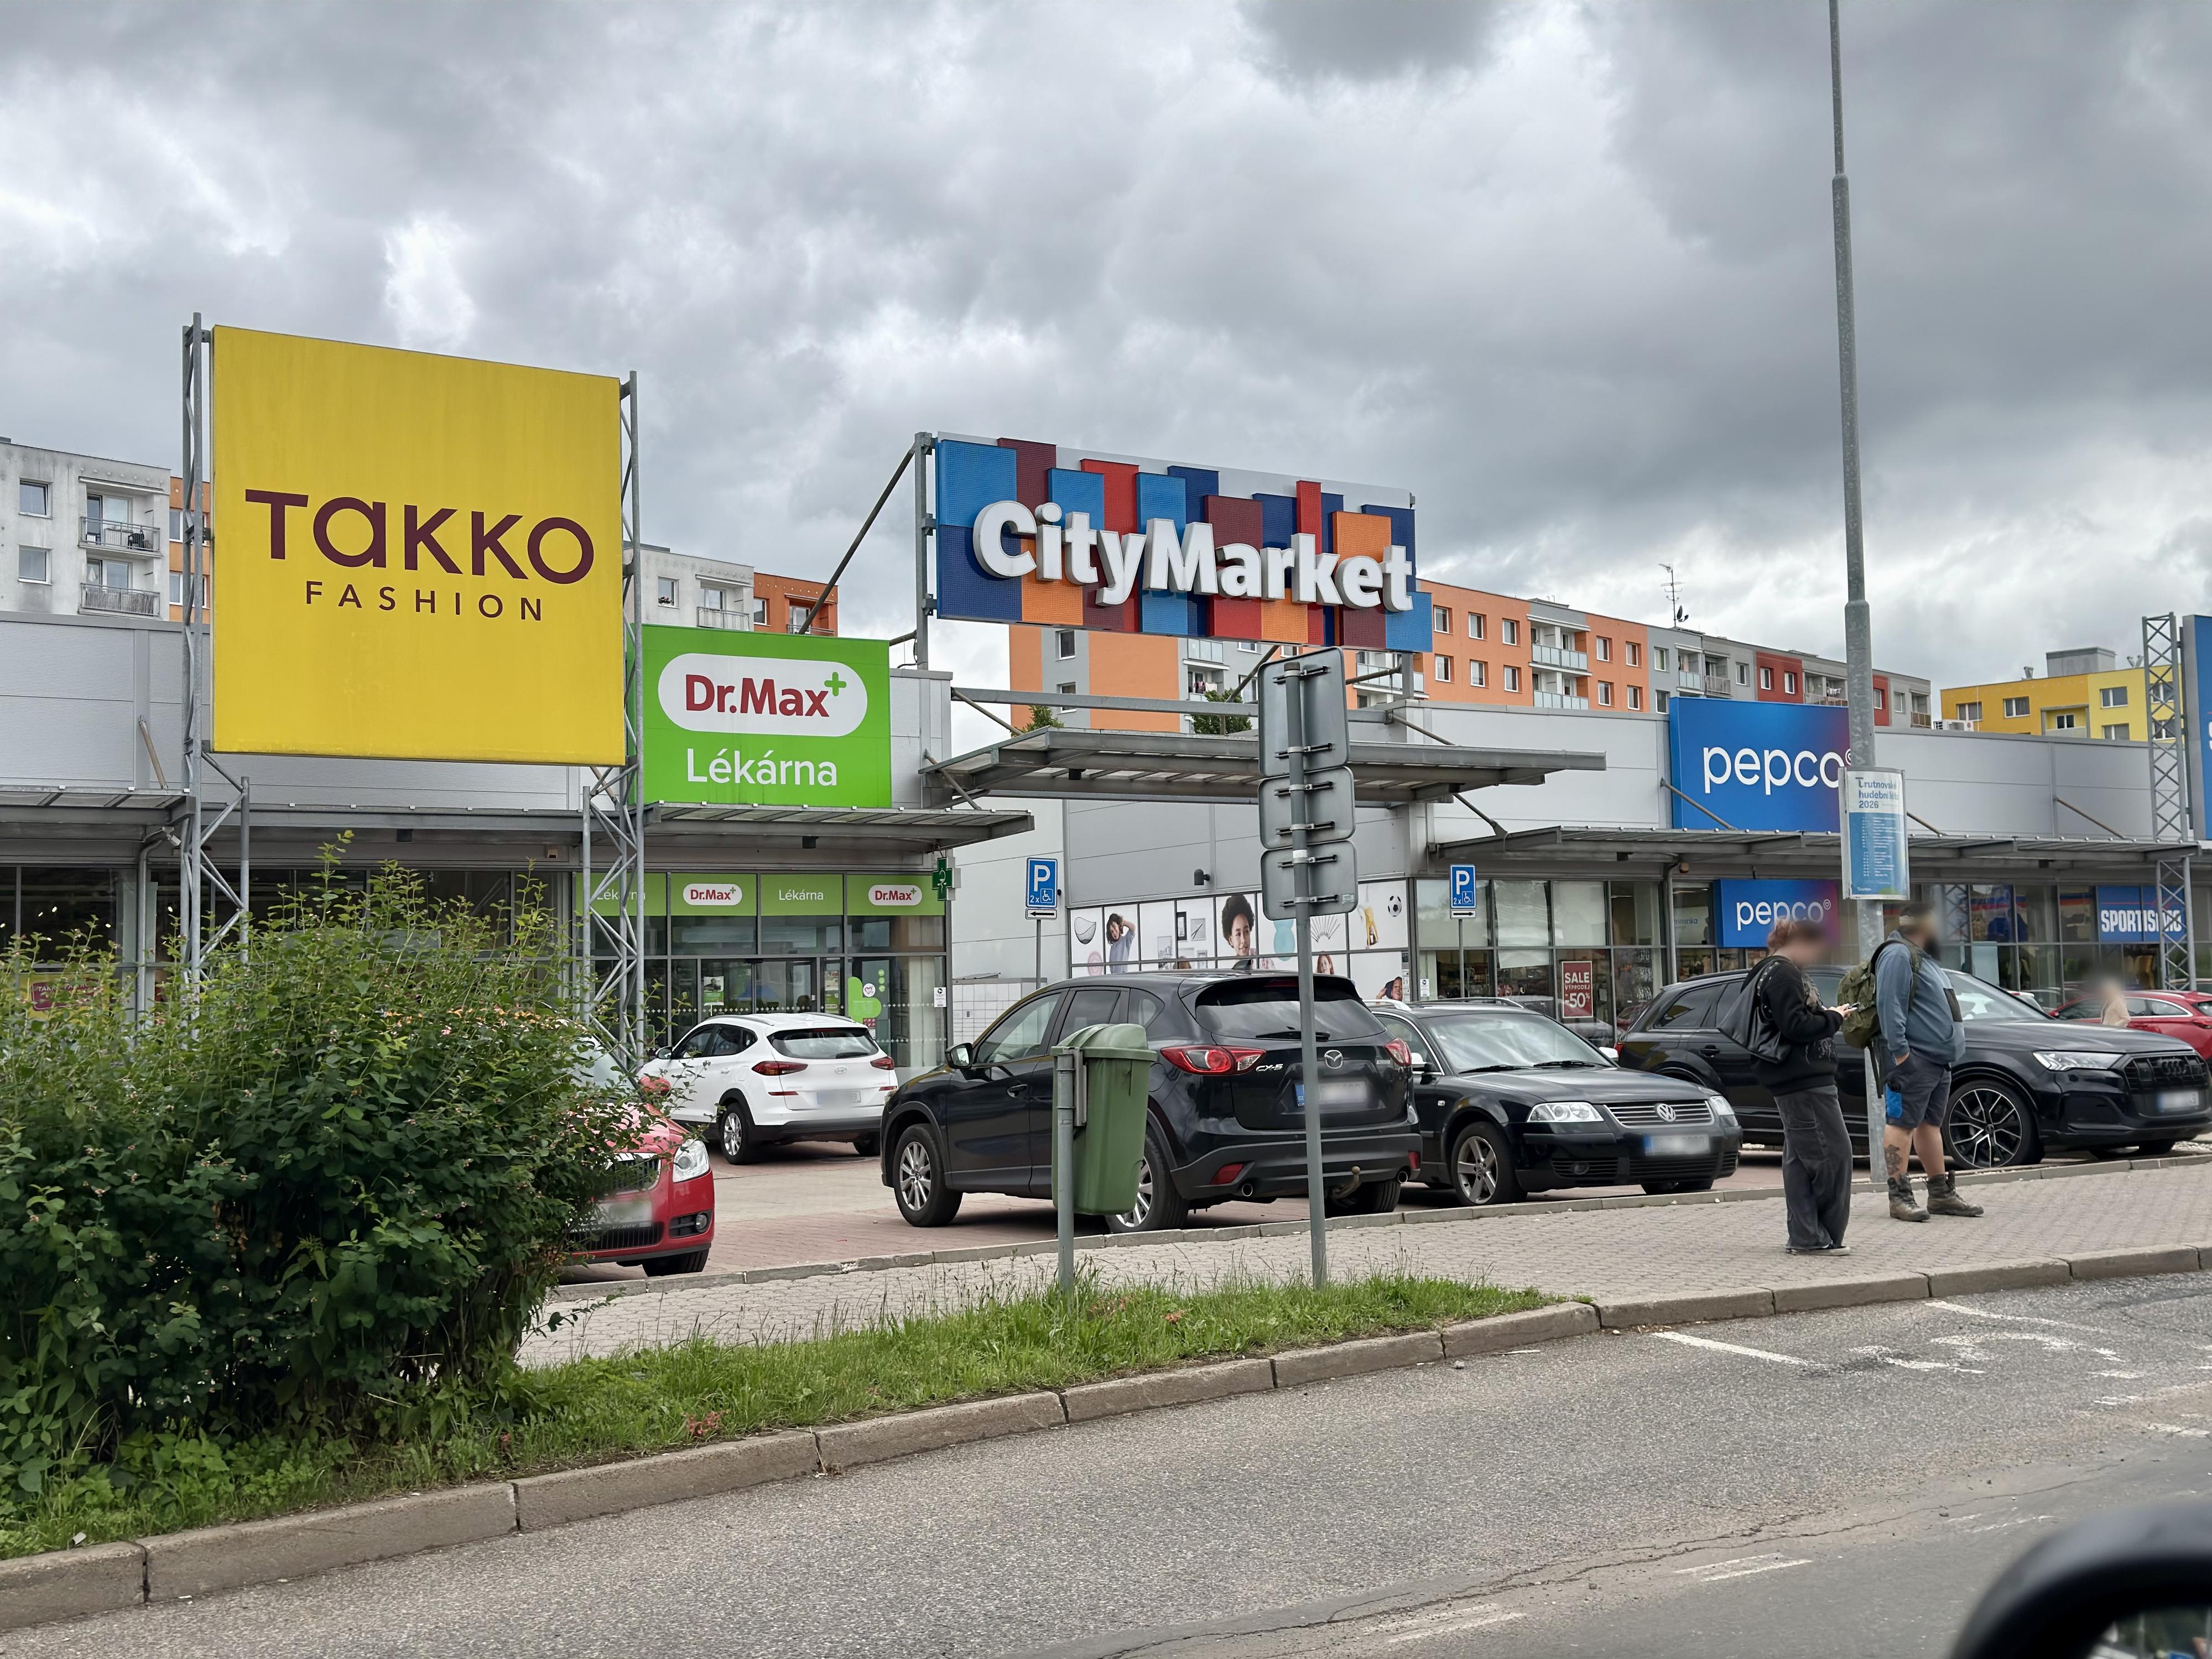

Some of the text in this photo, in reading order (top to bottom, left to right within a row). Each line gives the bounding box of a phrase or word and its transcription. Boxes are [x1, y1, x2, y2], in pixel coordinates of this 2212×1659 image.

[972, 500, 1414, 613] CityMarket
[305, 580, 543, 621] FASHION
[687, 748, 837, 787] Lékárna
[1703, 747, 1846, 795] pepco
[1859, 800, 1879, 808] 2026
[1033, 864, 1050, 892] P
[1456, 870, 1470, 895] P
[779, 889, 824, 901] Lékárna
[1736, 901, 1824, 931] pepco
[1564, 972, 1590, 983] SALE
[1256, 1063, 1283, 1072] CX-5
